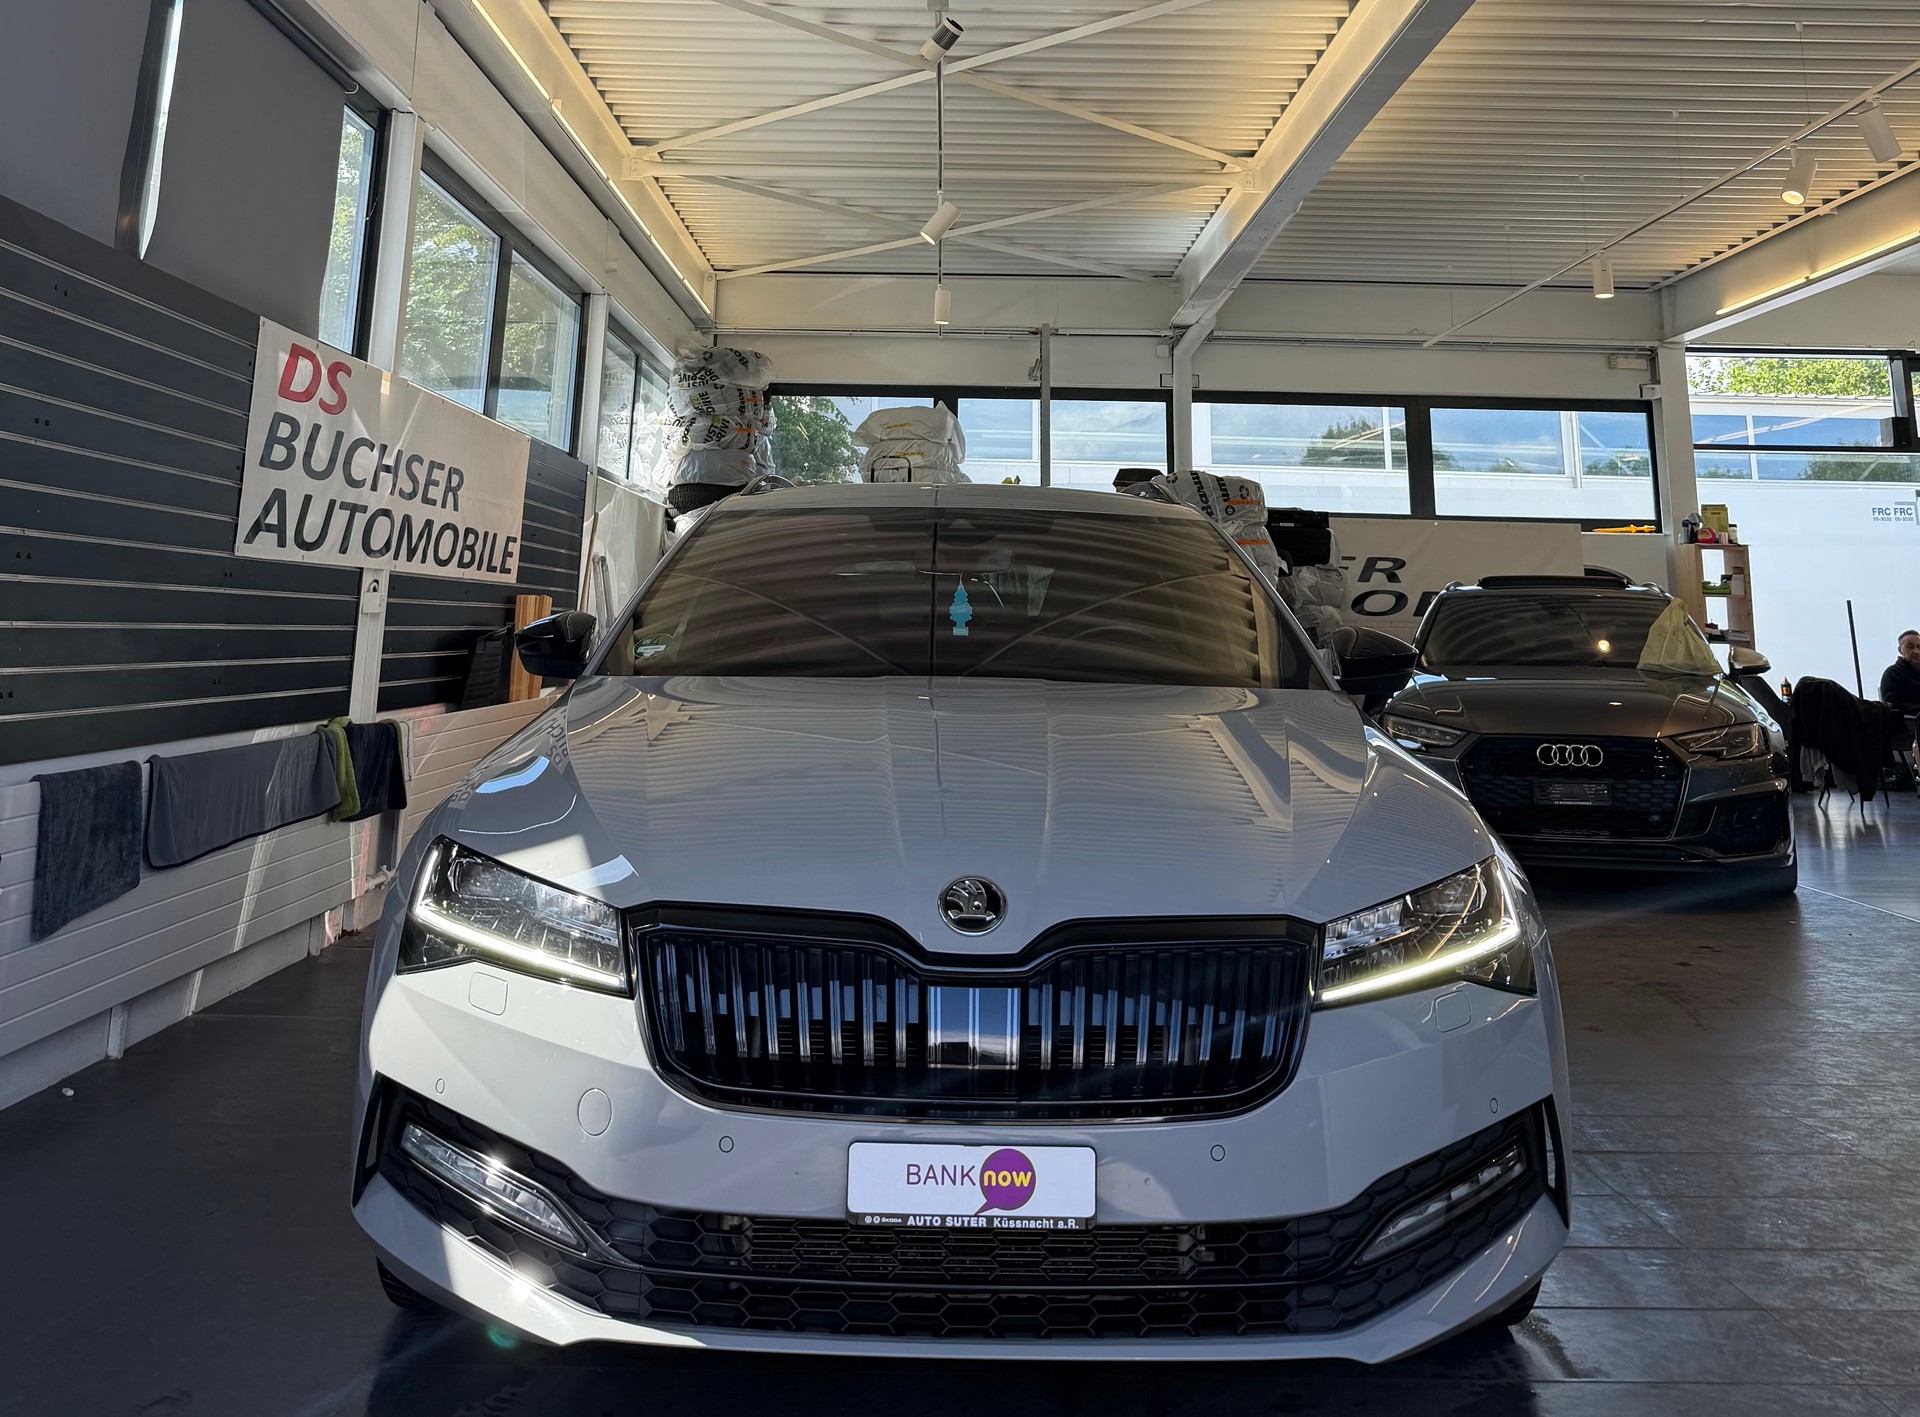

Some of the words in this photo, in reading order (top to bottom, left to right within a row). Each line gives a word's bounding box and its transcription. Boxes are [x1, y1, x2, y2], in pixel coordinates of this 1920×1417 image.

[278, 343, 351, 415] DS
[259, 411, 465, 512] BUCHSER
[1872, 507, 1891, 516] FRC
[1893, 507, 1913, 516] FRC
[243, 488, 518, 575] AUTOMOBILE
[906, 1164, 976, 1186] BANK
[983, 1171, 1032, 1188] now
[907, 1216, 941, 1226] AUTO
[945, 1216, 987, 1227] SUTER
[993, 1217, 1054, 1229] Küssnacht
[1057, 1219, 1079, 1229] a.R.
